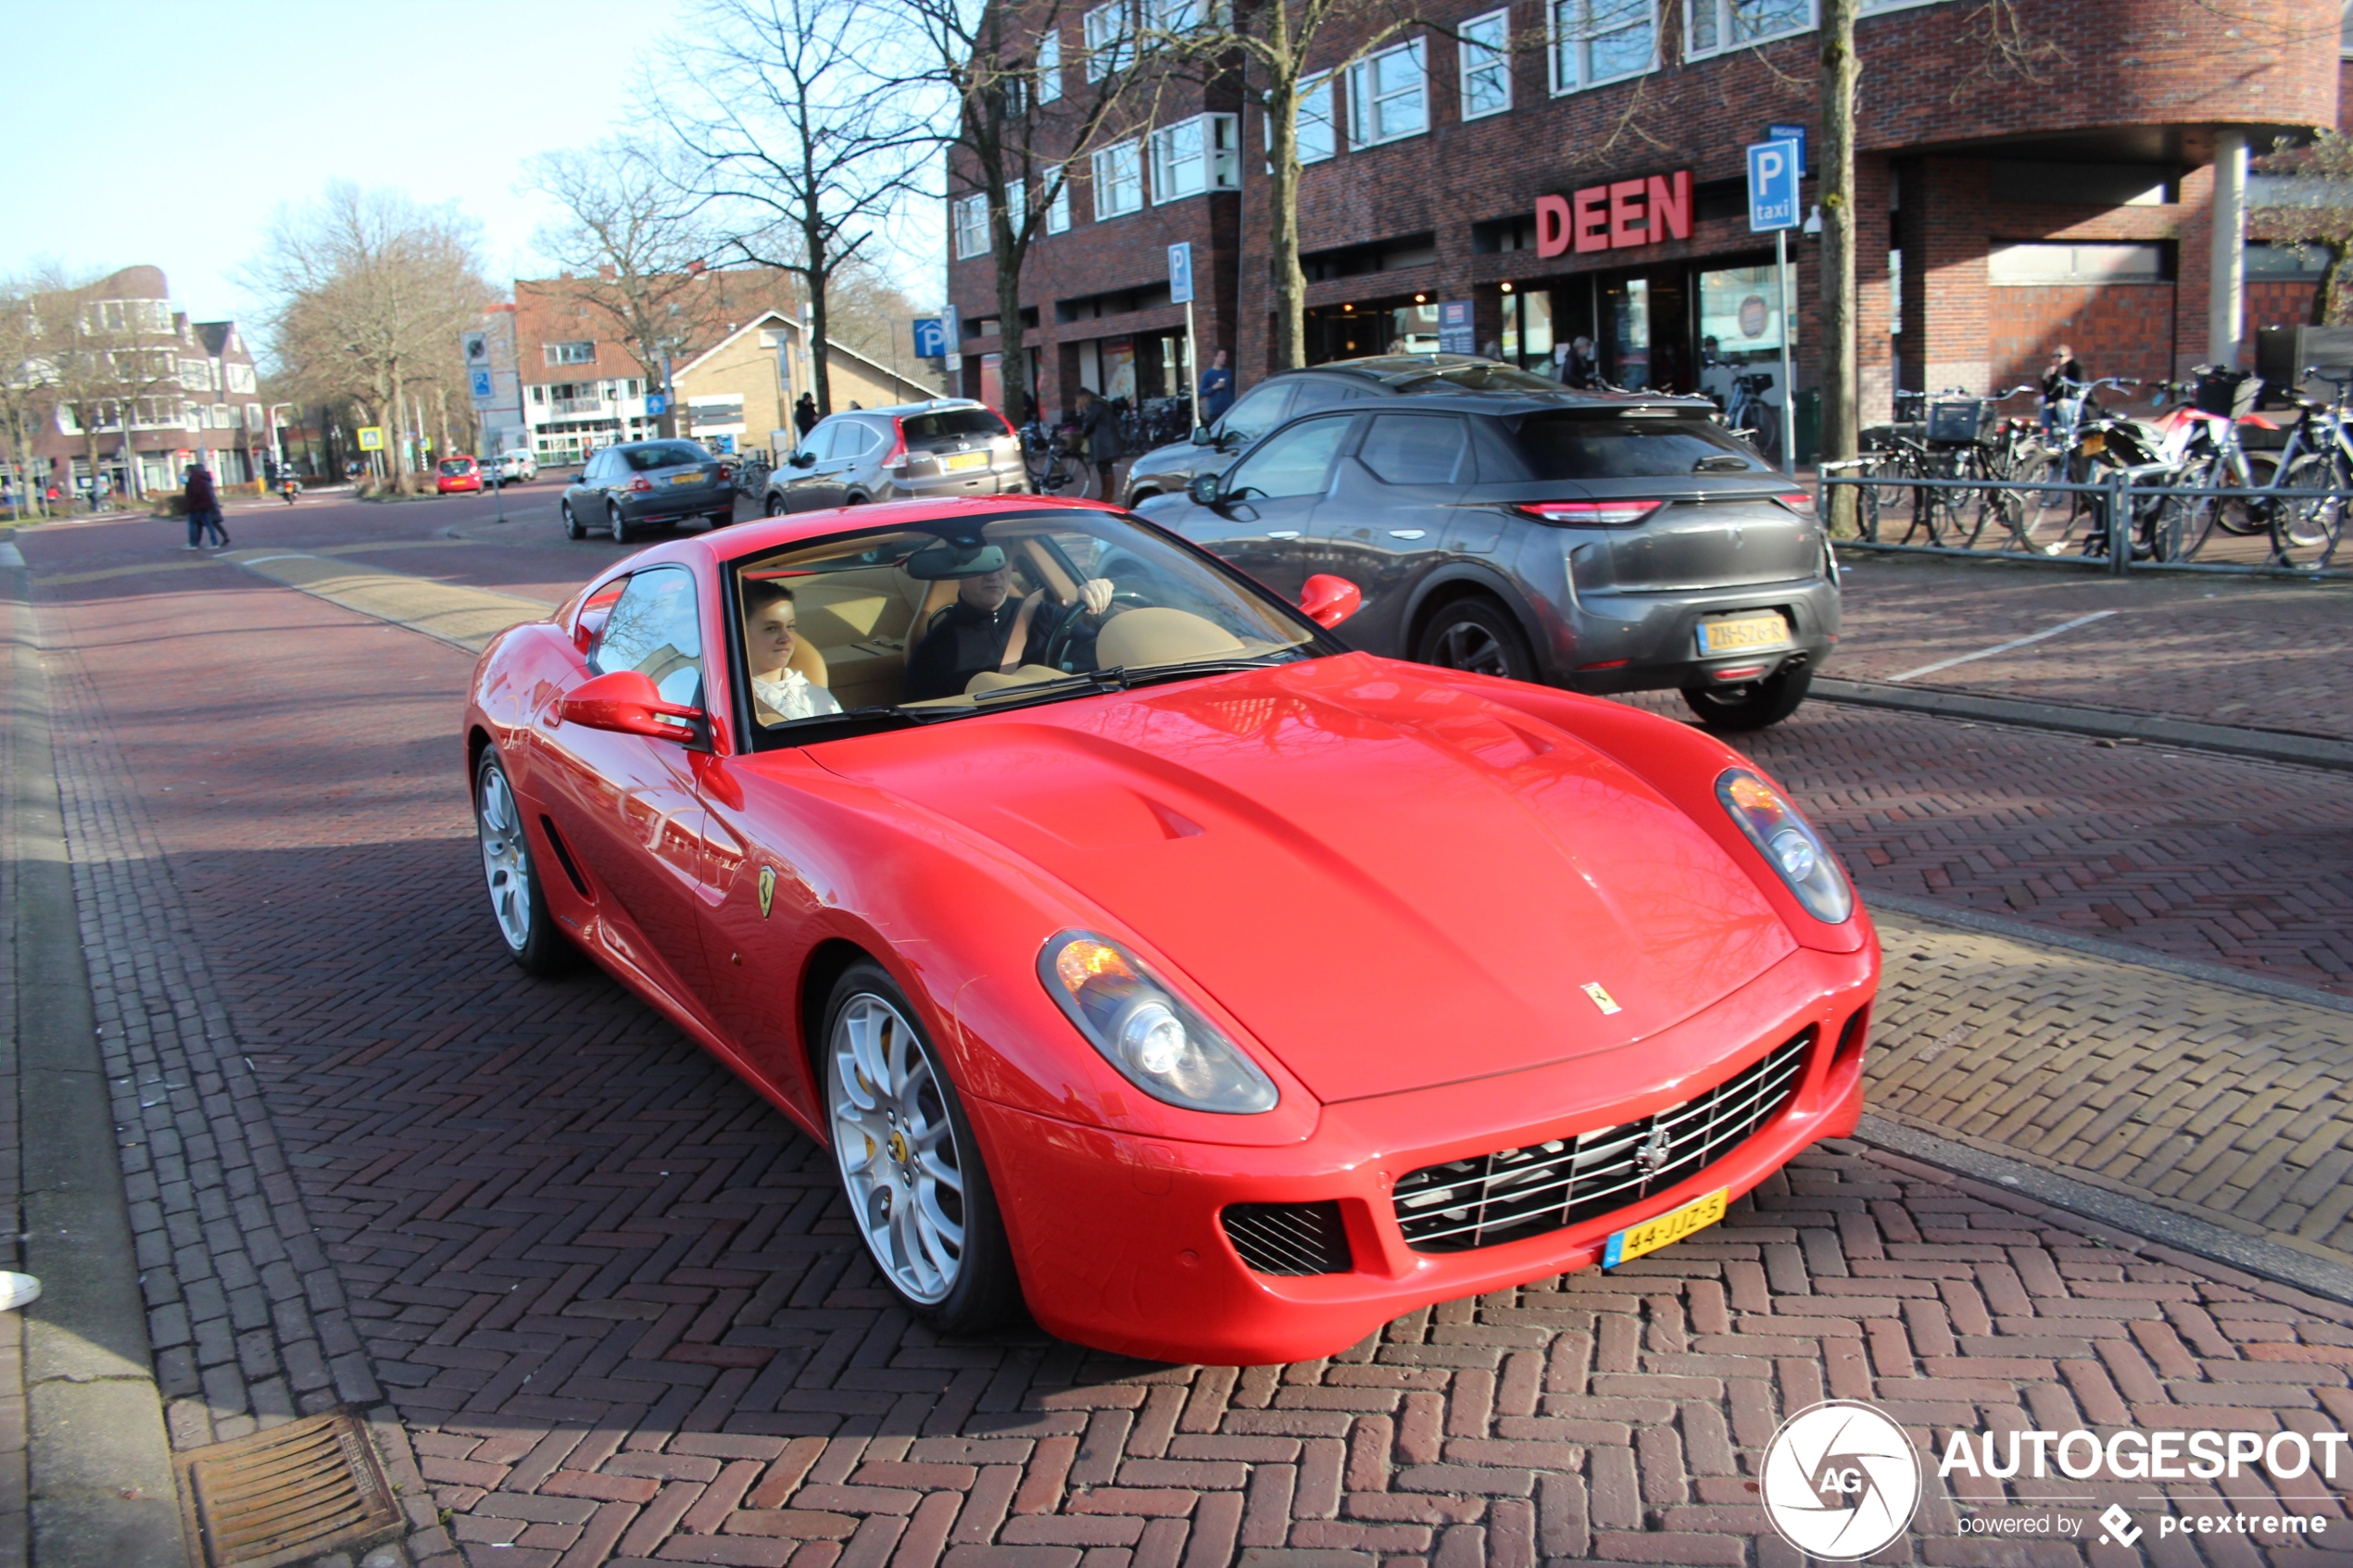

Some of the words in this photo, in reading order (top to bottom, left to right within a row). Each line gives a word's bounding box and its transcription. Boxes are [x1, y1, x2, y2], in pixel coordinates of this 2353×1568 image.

[1757, 151, 1783, 195] P
[1535, 169, 1693, 258] DEEN
[1756, 198, 1789, 220] taxi
[1172, 249, 1183, 280] P
[924, 329, 943, 356] P
[1629, 1198, 1719, 1251] 44-JJZ-5
